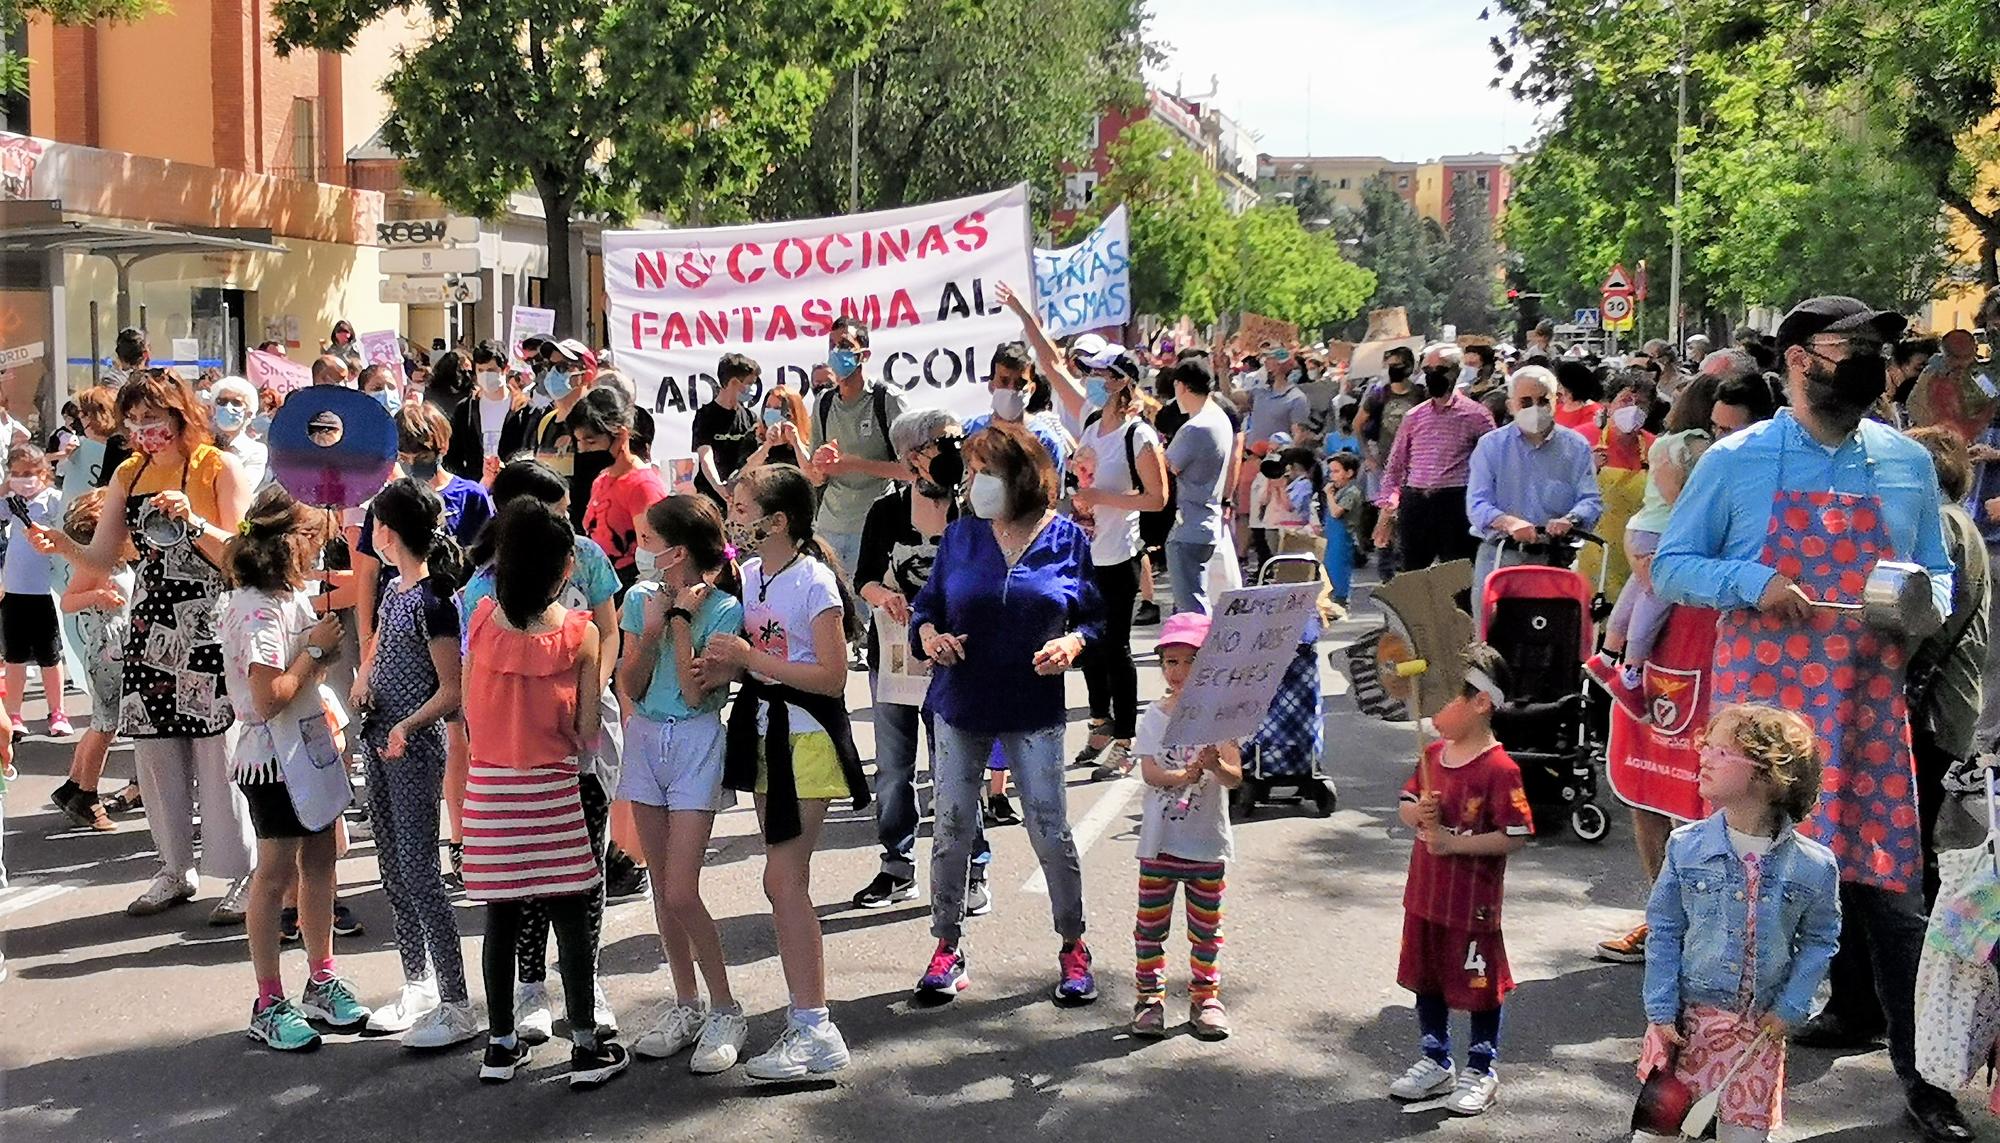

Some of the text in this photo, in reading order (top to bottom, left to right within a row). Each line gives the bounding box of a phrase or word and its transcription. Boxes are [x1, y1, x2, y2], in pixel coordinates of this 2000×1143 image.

[726, 211, 989, 285] COCINAS
[631, 277, 1002, 350] FANTASMA AL
[1607, 301, 1625, 311] 30
[647, 372, 763, 415] AD
[1463, 940, 1487, 977] 4
